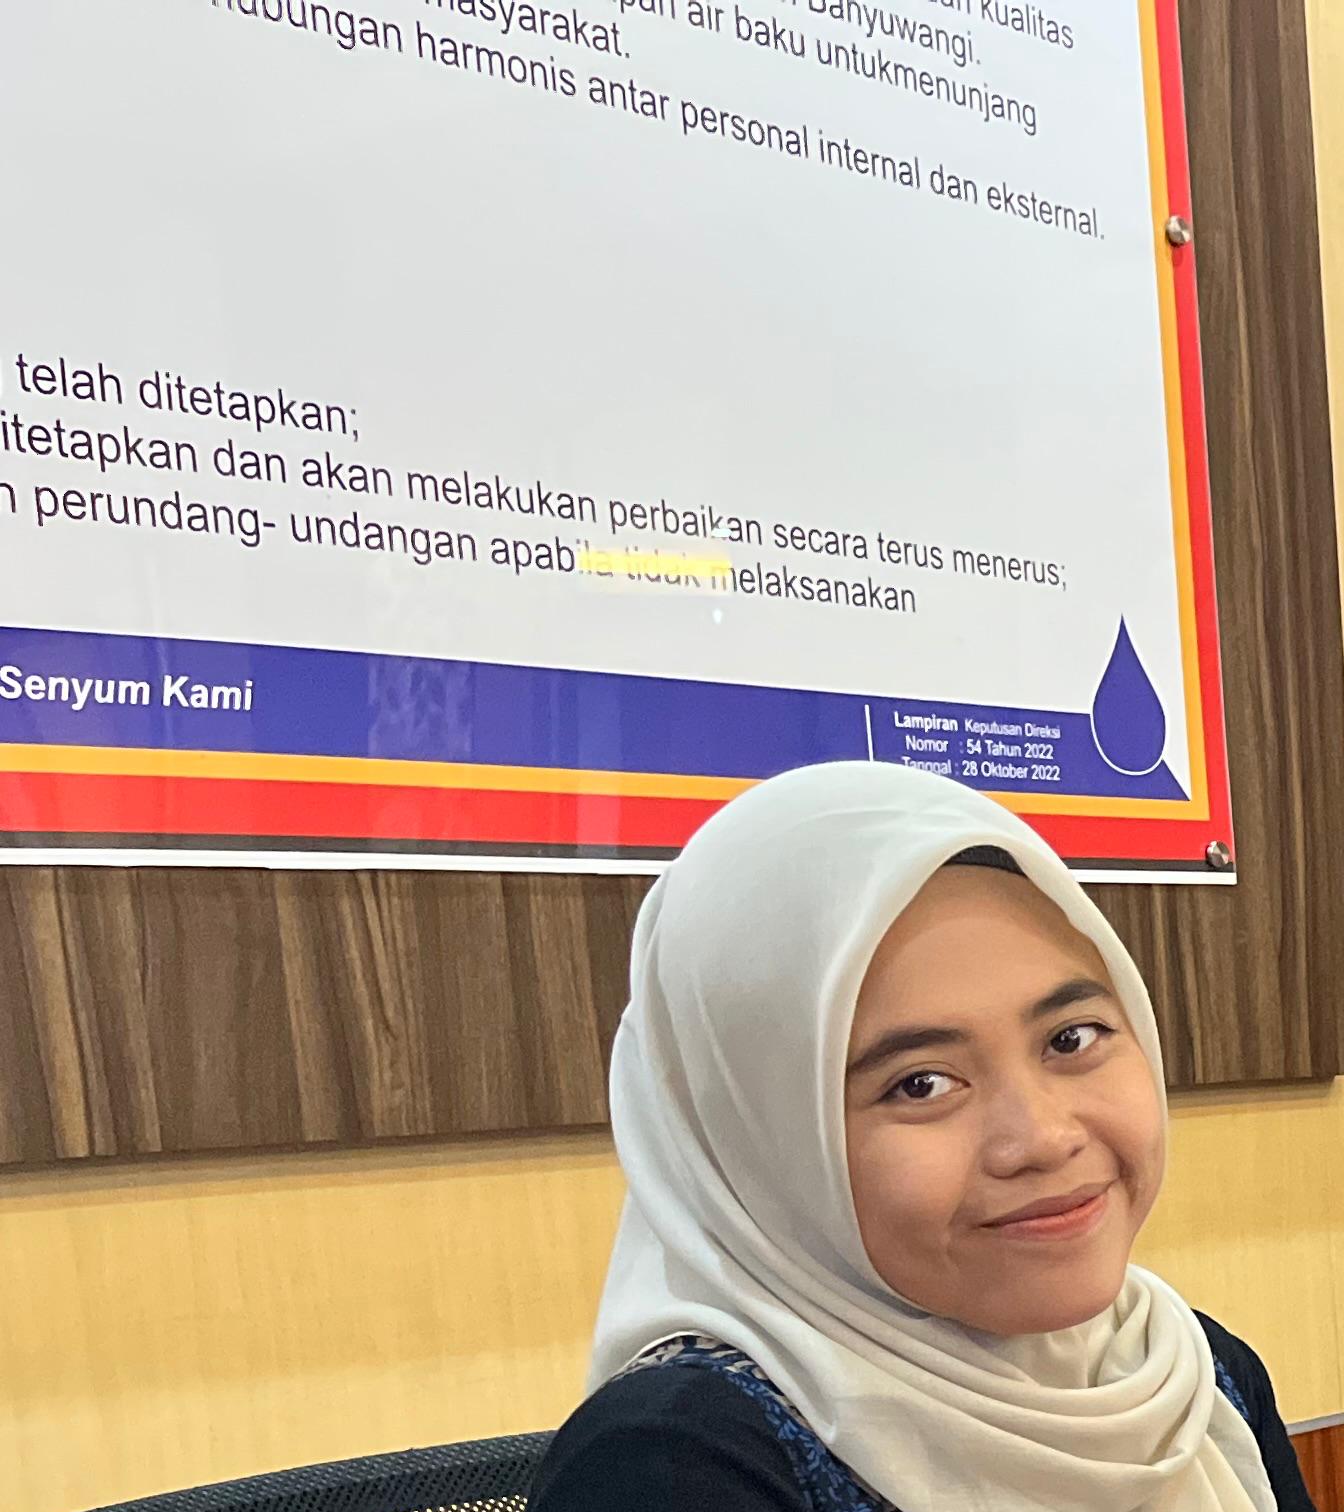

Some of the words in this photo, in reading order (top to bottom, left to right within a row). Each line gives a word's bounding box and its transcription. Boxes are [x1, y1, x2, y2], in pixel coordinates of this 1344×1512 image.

[981, 0, 1074, 49] kualitas
[688, 0, 724, 33] air
[734, 4, 806, 58] baku
[815, 38, 1038, 137] untukmenunjang
[211, 0, 404, 53] ubungan
[416, 20, 578, 98] harmonis
[587, 75, 670, 123] antar
[680, 99, 810, 160] personal
[818, 129, 921, 191] internal
[929, 161, 979, 206] dan
[986, 184, 1105, 240] eksternal.
[15, 352, 122, 406] telah
[137, 368, 360, 442] ditetapkan;
[34, 483, 277, 547] perundang-
[290, 511, 478, 566] undangan
[711, 558, 917, 614] melaksanakan
[212, 438, 287, 485] dan
[301, 450, 394, 498] akan
[406, 469, 597, 524] melakukan
[609, 497, 763, 548] perbaikan
[772, 522, 869, 561] secara
[875, 532, 945, 572] terus
[952, 546, 1068, 592] menerus;
[0, 665, 151, 711] Senyum
[161, 673, 254, 712] Kami
[893, 710, 959, 733] Lampiran
[964, 717, 1023, 737] Keputusan
[904, 734, 949, 753] Nomor
[966, 738, 982, 755] 54
[984, 739, 1023, 758] Tahun
[1024, 742, 1055, 760] 2022
[961, 759, 979, 777] 28
[980, 760, 1029, 779] Oktober
[1030, 763, 1061, 782] 2022
